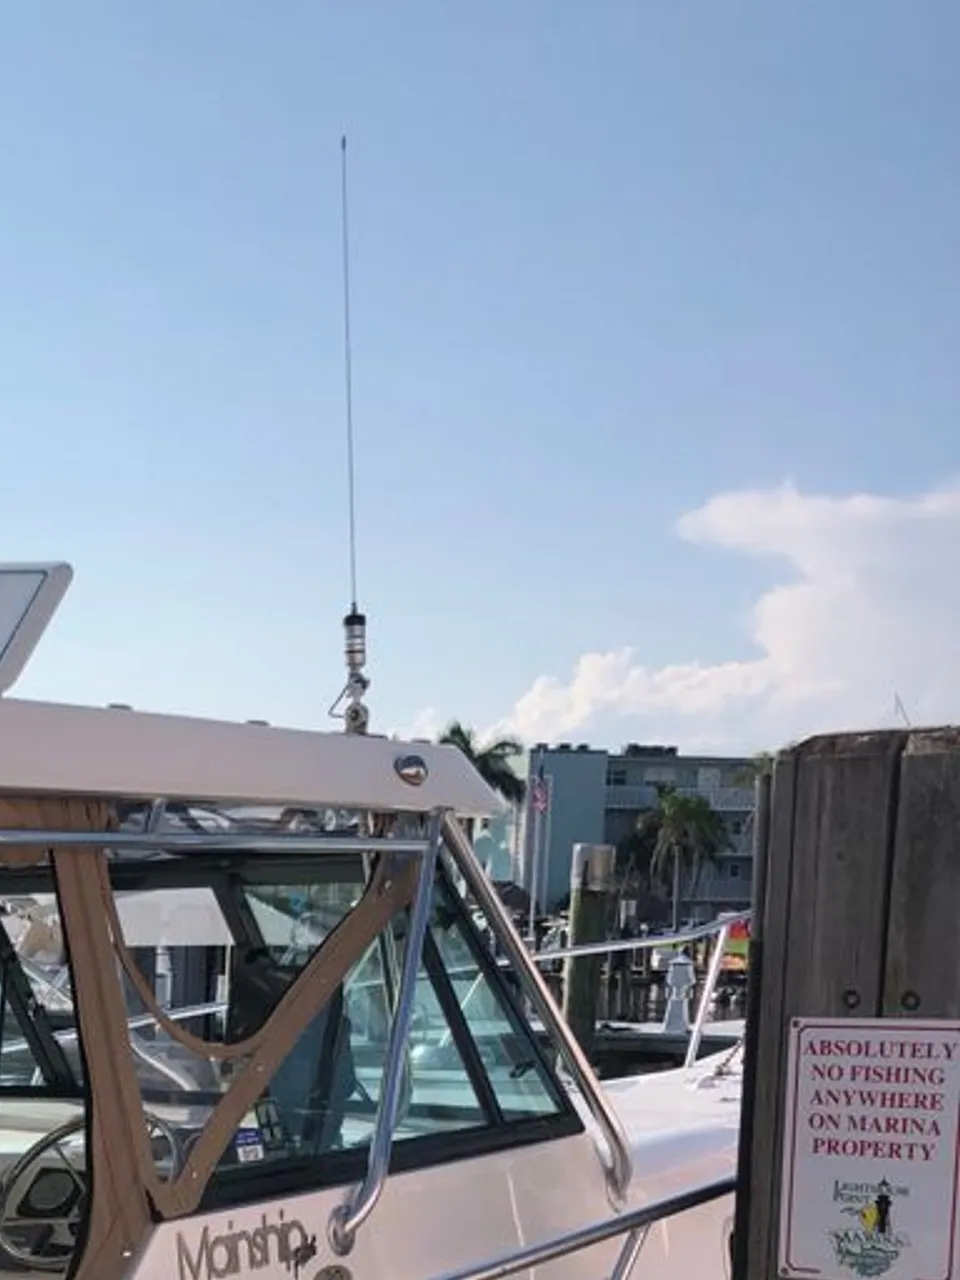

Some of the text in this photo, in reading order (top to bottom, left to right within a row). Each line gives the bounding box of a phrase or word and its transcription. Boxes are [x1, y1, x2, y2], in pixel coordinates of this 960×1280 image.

[803, 1040, 957, 1061] ABSOLUTELY
[810, 1064, 945, 1086] NO FISHING
[809, 1090, 945, 1111] ANYWHERE
[808, 1112, 942, 1137] ON MARINA
[812, 1137, 937, 1161] PROPERTY
